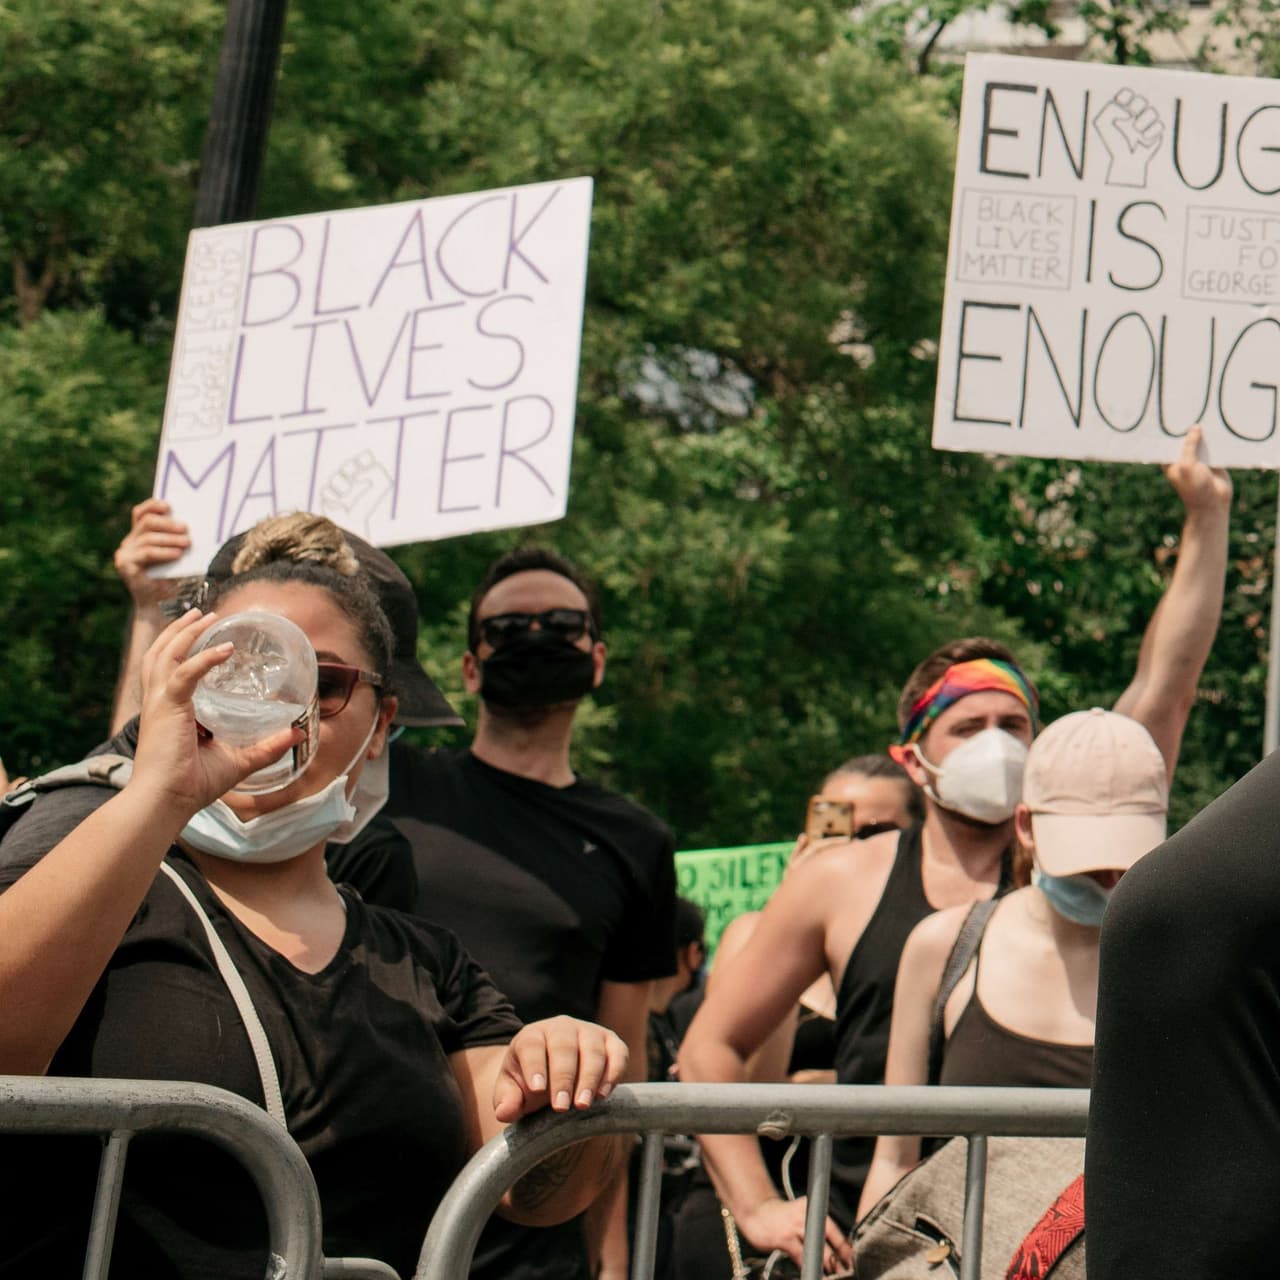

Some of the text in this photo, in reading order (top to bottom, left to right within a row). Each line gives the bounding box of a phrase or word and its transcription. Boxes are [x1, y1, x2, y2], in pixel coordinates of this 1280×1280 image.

[977, 195, 1065, 226] BLACK
[976, 224, 1061, 254] LIVES
[1085, 199, 1169, 292] IS
[241, 186, 562, 328] BLACK
[963, 250, 1064, 281] MATTER
[1187, 269, 1279, 297] GEORGE
[228, 294, 536, 425] LIVES
